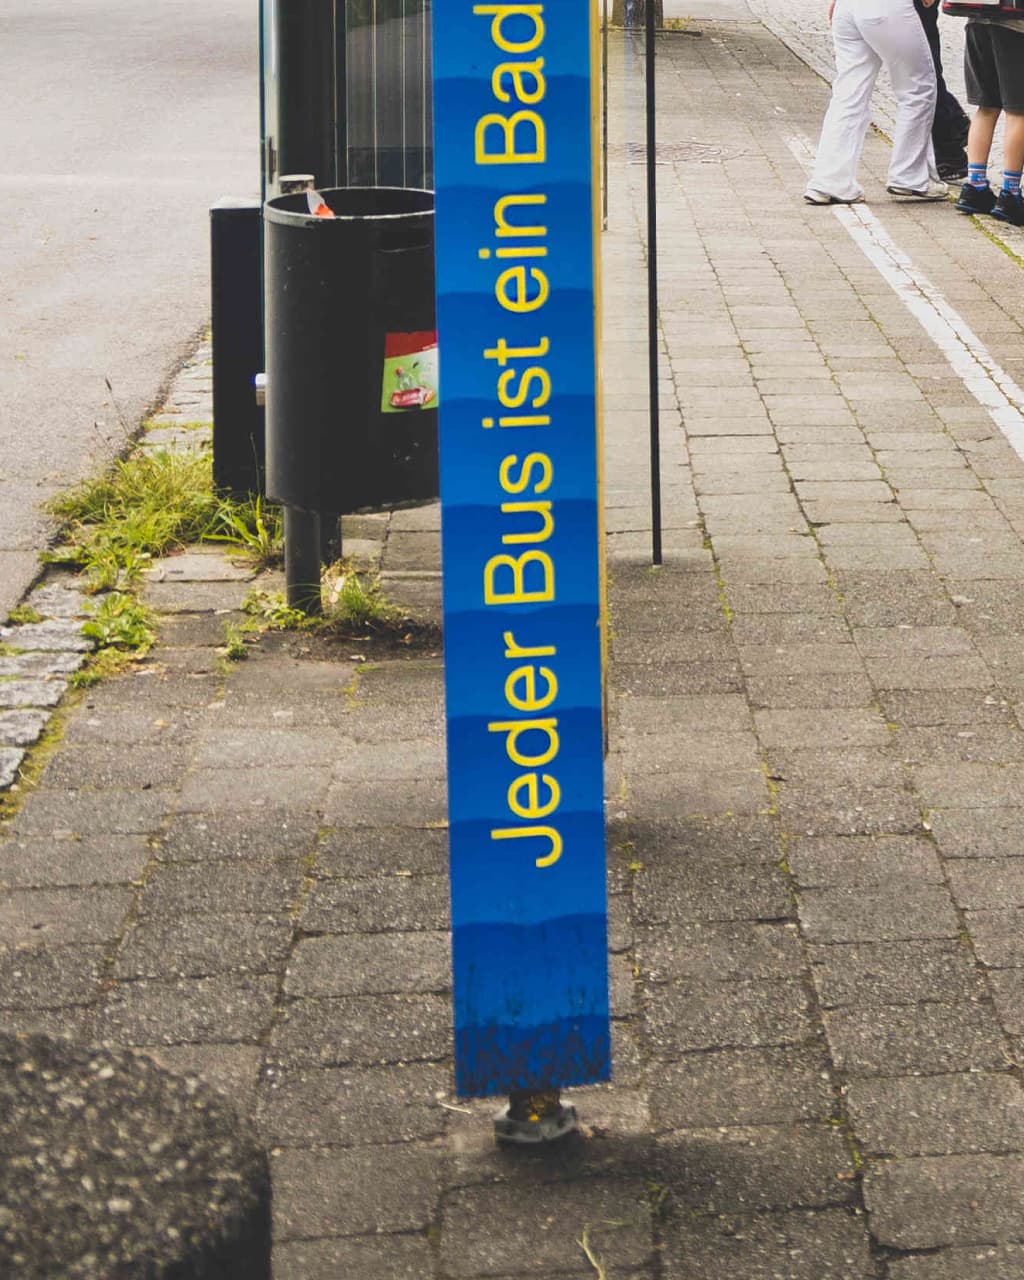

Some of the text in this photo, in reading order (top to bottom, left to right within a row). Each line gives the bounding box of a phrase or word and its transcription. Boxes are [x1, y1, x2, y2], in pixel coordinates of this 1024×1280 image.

[478, 194, 549, 314] ein
[482, 336, 551, 429] ist
[483, 452, 555, 606] Bus
[488, 631, 563, 869] Jeder
